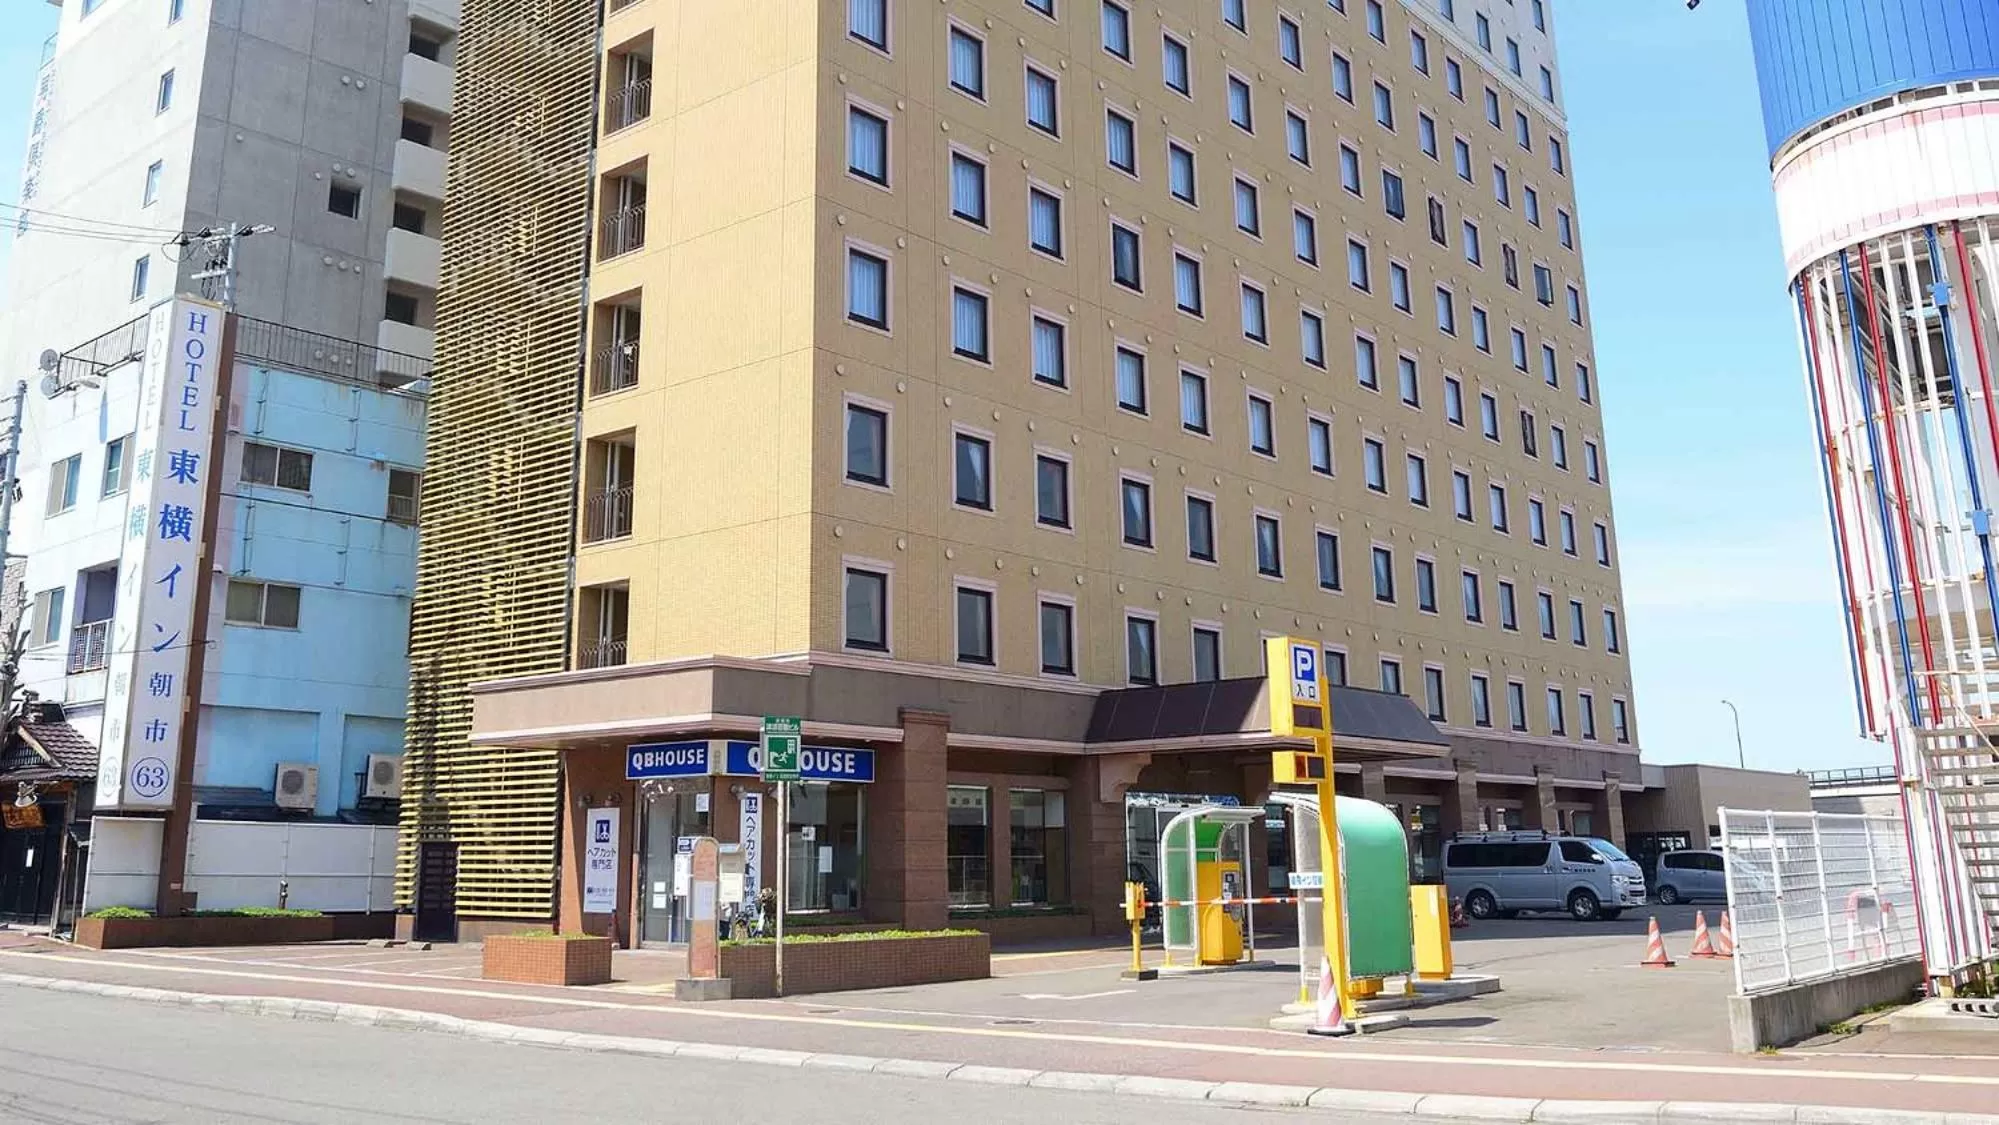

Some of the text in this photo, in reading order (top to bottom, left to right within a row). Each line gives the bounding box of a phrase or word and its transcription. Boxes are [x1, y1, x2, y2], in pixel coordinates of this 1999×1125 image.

[143, 310, 165, 431] HOTEL
[178, 310, 207, 432] HOTEL
[1296, 649, 1312, 678] P
[1297, 683, 1316, 699] 入口
[748, 746, 856, 774] QOUSE
[135, 764, 166, 790] 63
